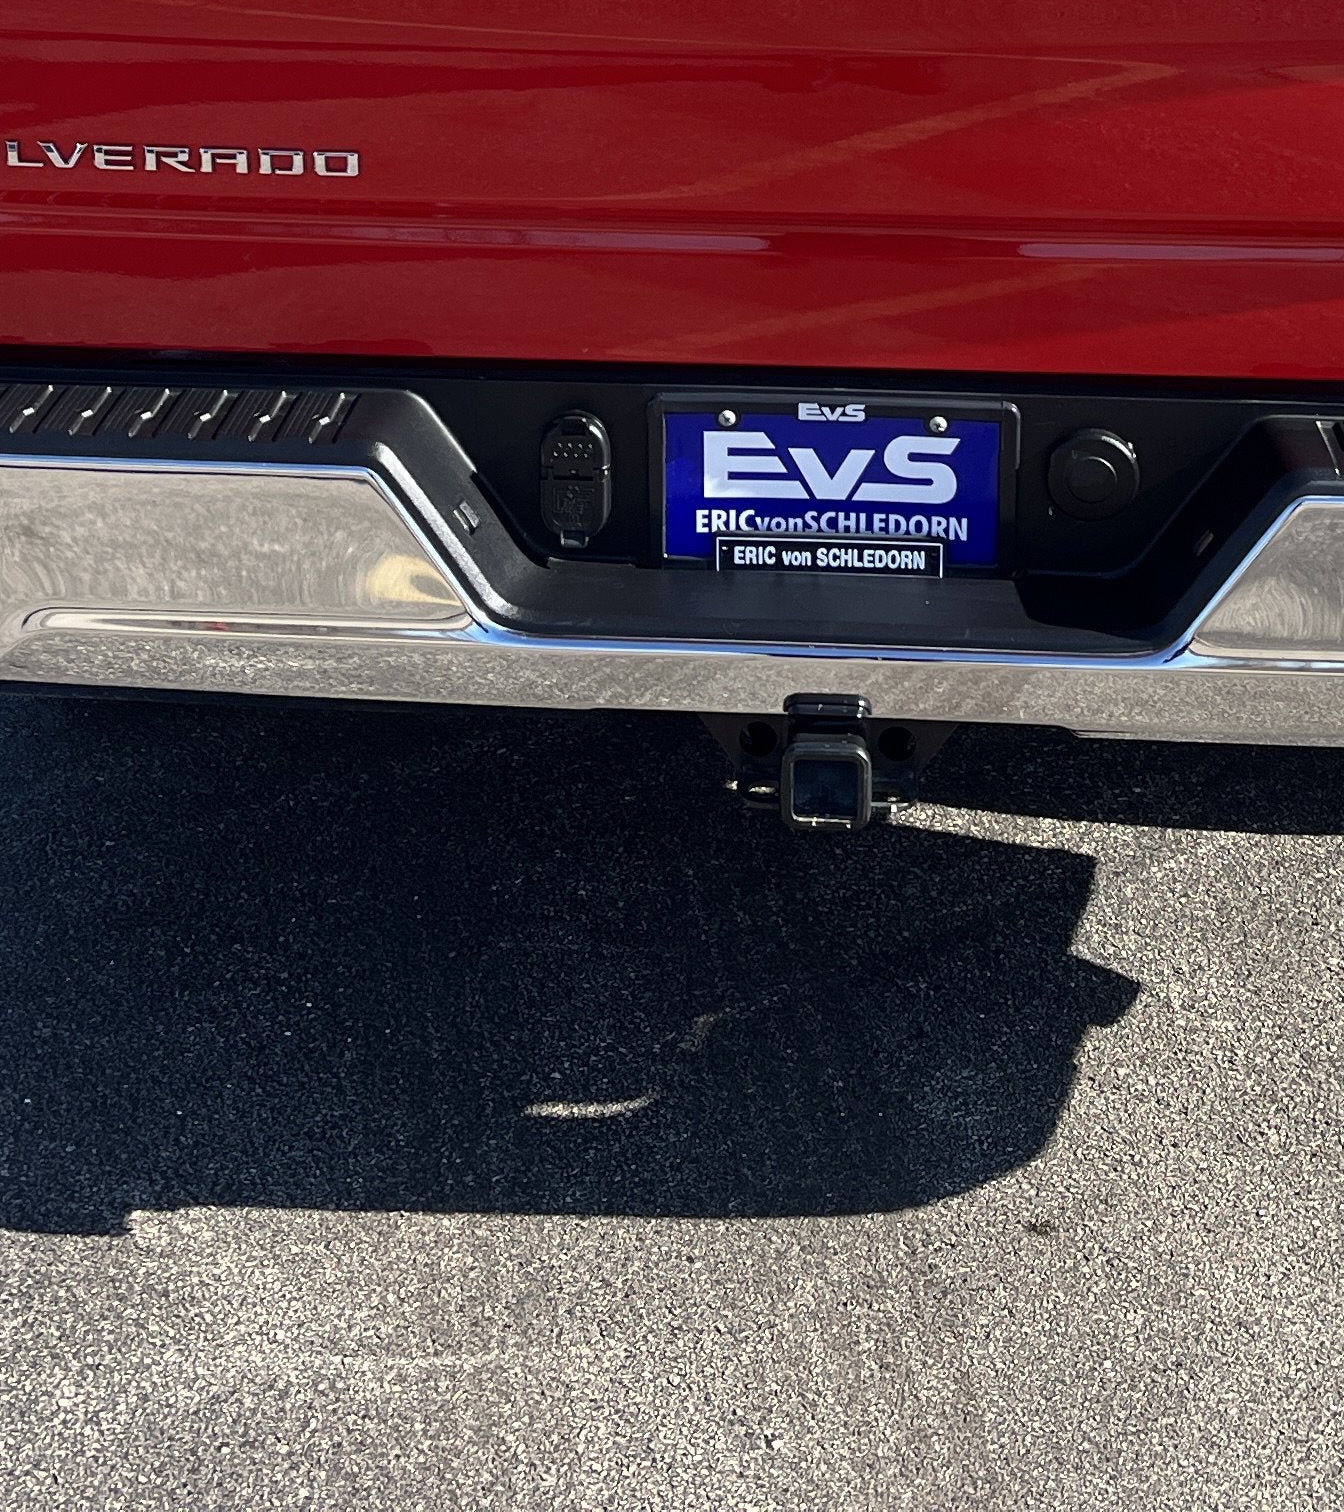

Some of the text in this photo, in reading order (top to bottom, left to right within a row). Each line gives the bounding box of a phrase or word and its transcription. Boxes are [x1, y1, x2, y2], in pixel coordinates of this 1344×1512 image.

[733, 545, 926, 570] ERIC von SCHLEDORN
